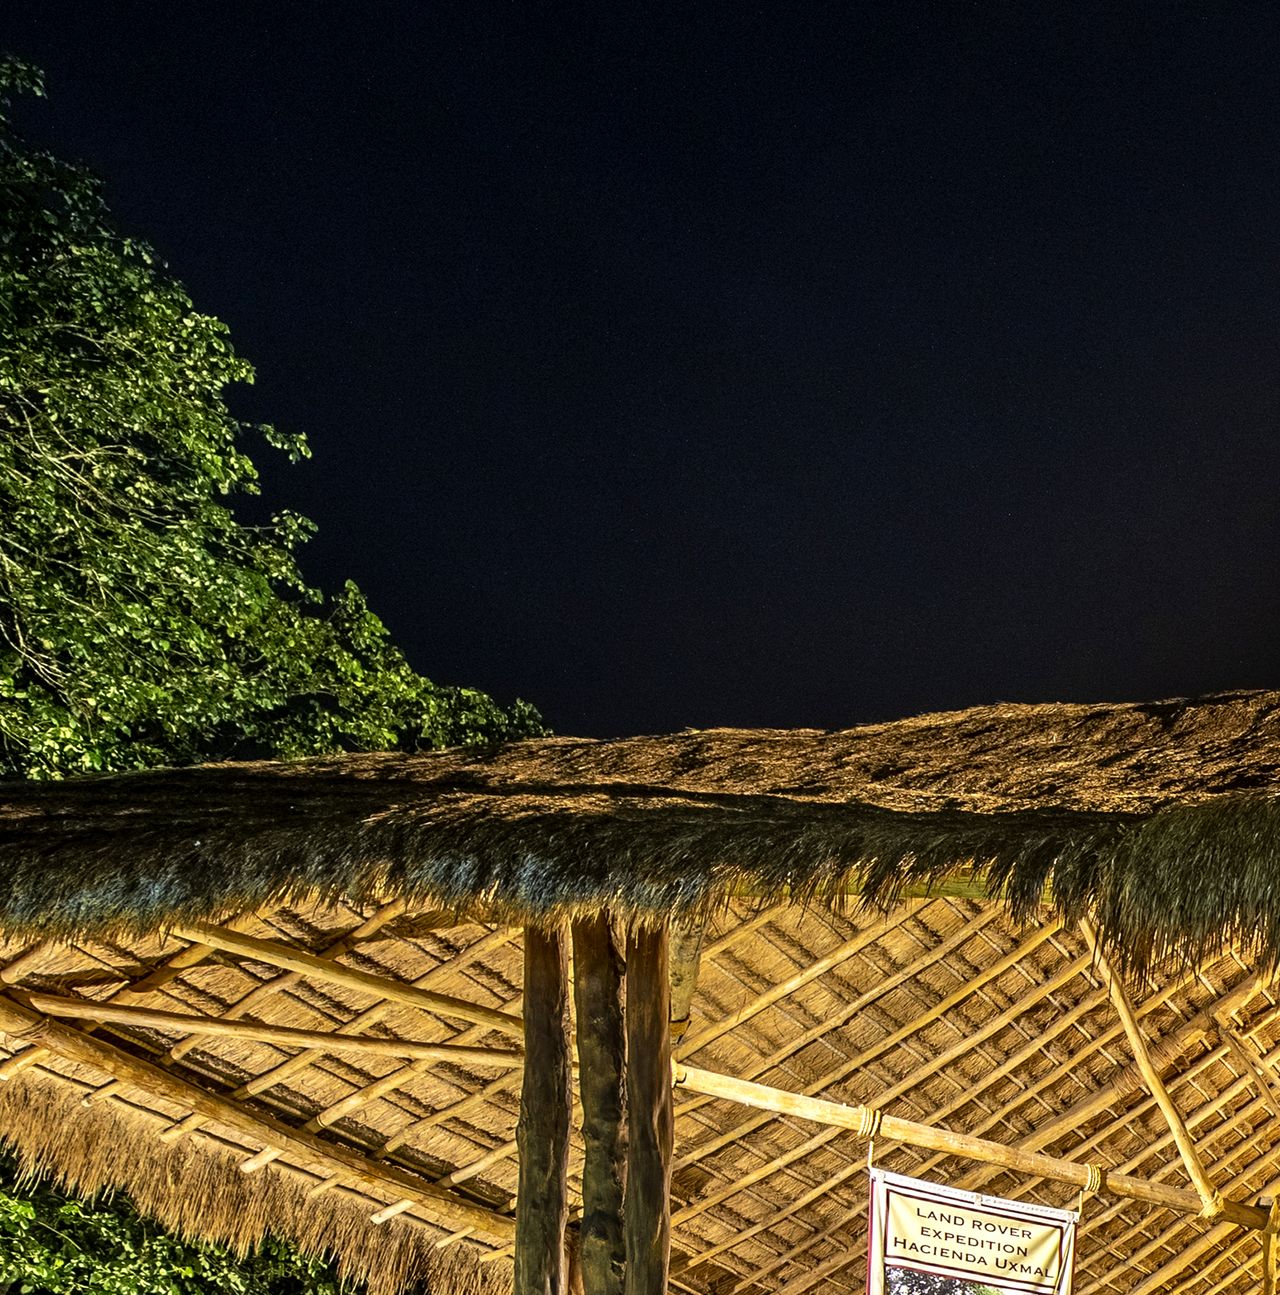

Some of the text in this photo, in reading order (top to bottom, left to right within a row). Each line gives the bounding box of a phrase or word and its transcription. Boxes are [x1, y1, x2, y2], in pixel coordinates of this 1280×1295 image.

[916, 1207, 1032, 1239] LAND ROVER
[893, 1236, 1054, 1278] HACIENDA UXMAL
[920, 1226, 1028, 1257] EXPEDITION
